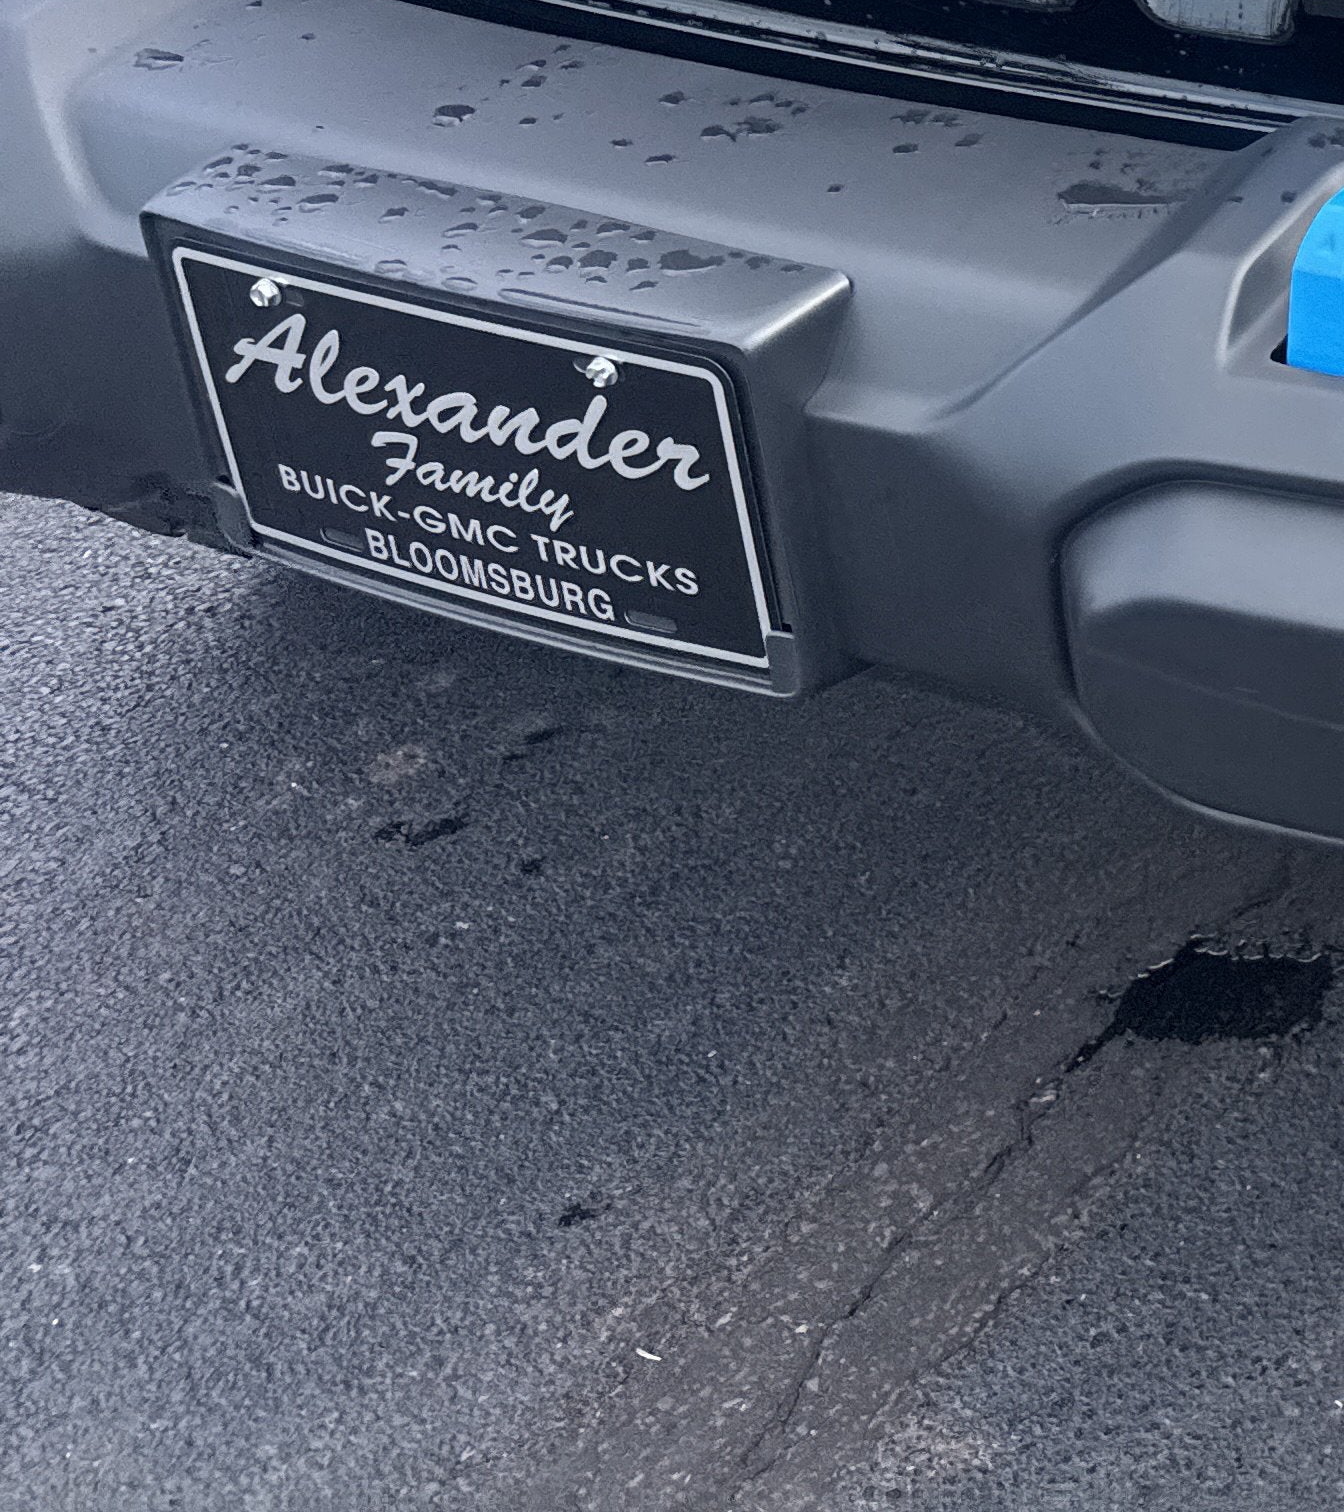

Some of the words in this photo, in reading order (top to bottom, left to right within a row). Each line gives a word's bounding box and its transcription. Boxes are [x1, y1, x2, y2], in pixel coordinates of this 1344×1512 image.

[225, 313, 710, 491] Alexander
[277, 463, 518, 553] BUICK-GMC
[530, 534, 699, 596] TRUCKS
[371, 431, 574, 532] Family
[364, 528, 616, 621] BLOOMSBURG
